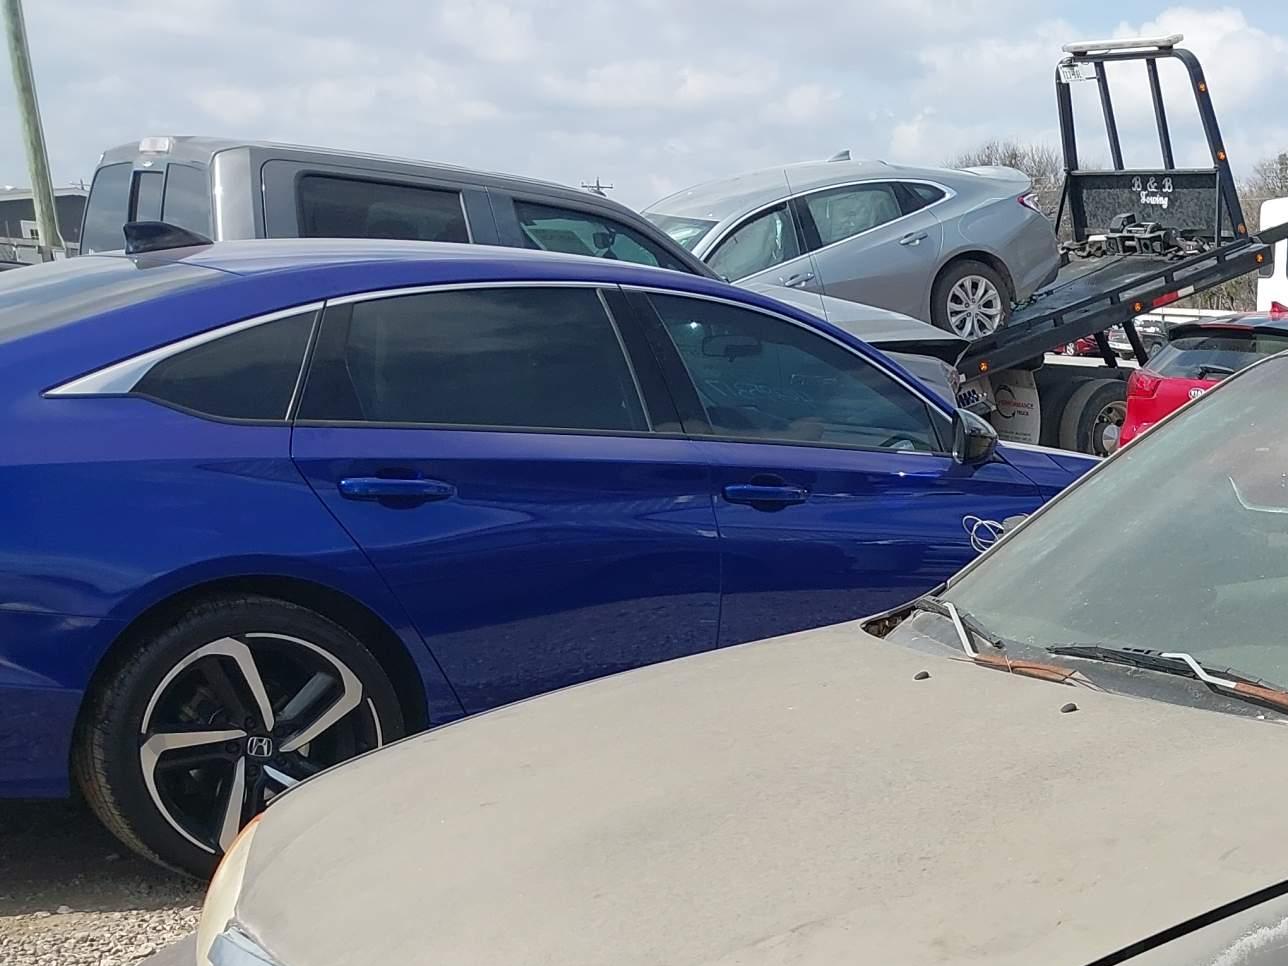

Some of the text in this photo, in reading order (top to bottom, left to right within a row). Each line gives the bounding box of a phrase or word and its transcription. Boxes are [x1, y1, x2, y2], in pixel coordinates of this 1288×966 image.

[1131, 176, 1173, 192] B & B
[1140, 190, 1169, 209] Towing
